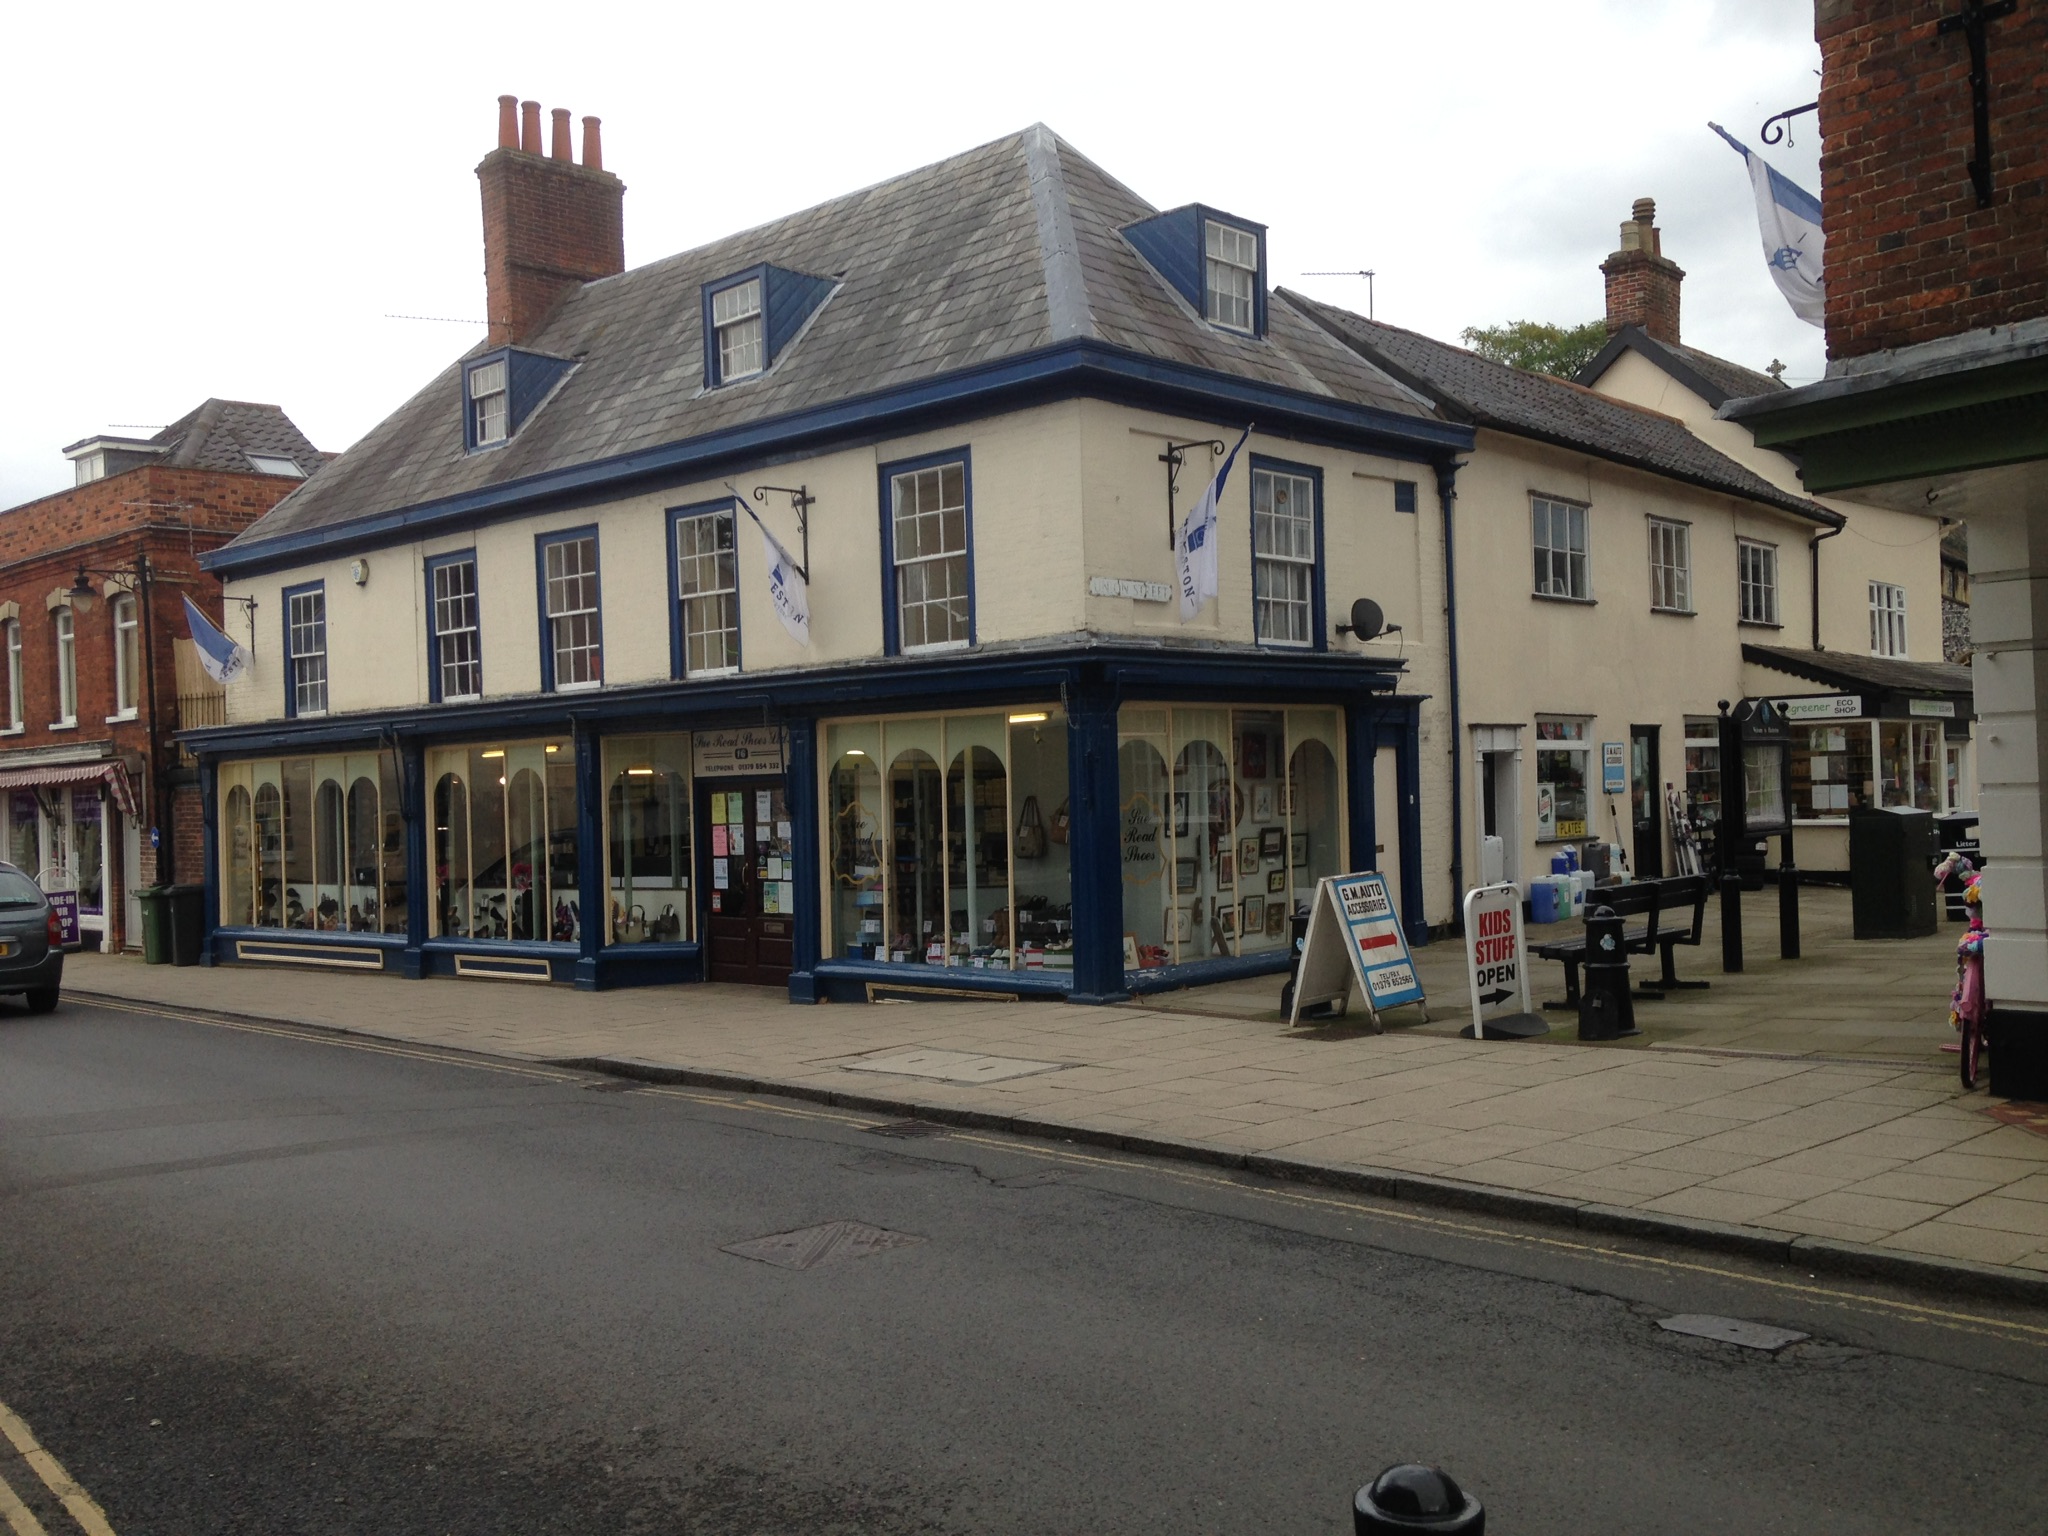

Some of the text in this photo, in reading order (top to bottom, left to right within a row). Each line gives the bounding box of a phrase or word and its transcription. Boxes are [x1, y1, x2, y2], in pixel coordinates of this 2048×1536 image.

[1094, 581, 1129, 595] UNON
[1836, 699, 1854, 707] ECO
[1834, 706, 1857, 714] SHOP
[705, 764, 734, 772] TELEPHONE
[1560, 822, 1582, 834] PLATES
[49, 895, 75, 906] ADE-IN
[1347, 898, 1388, 916] ACCESSORIES
[1479, 908, 1511, 938] KIDS
[1475, 934, 1515, 966] STUFF
[1476, 963, 1516, 987] OPEN
[1372, 978, 1391, 991] 01379
